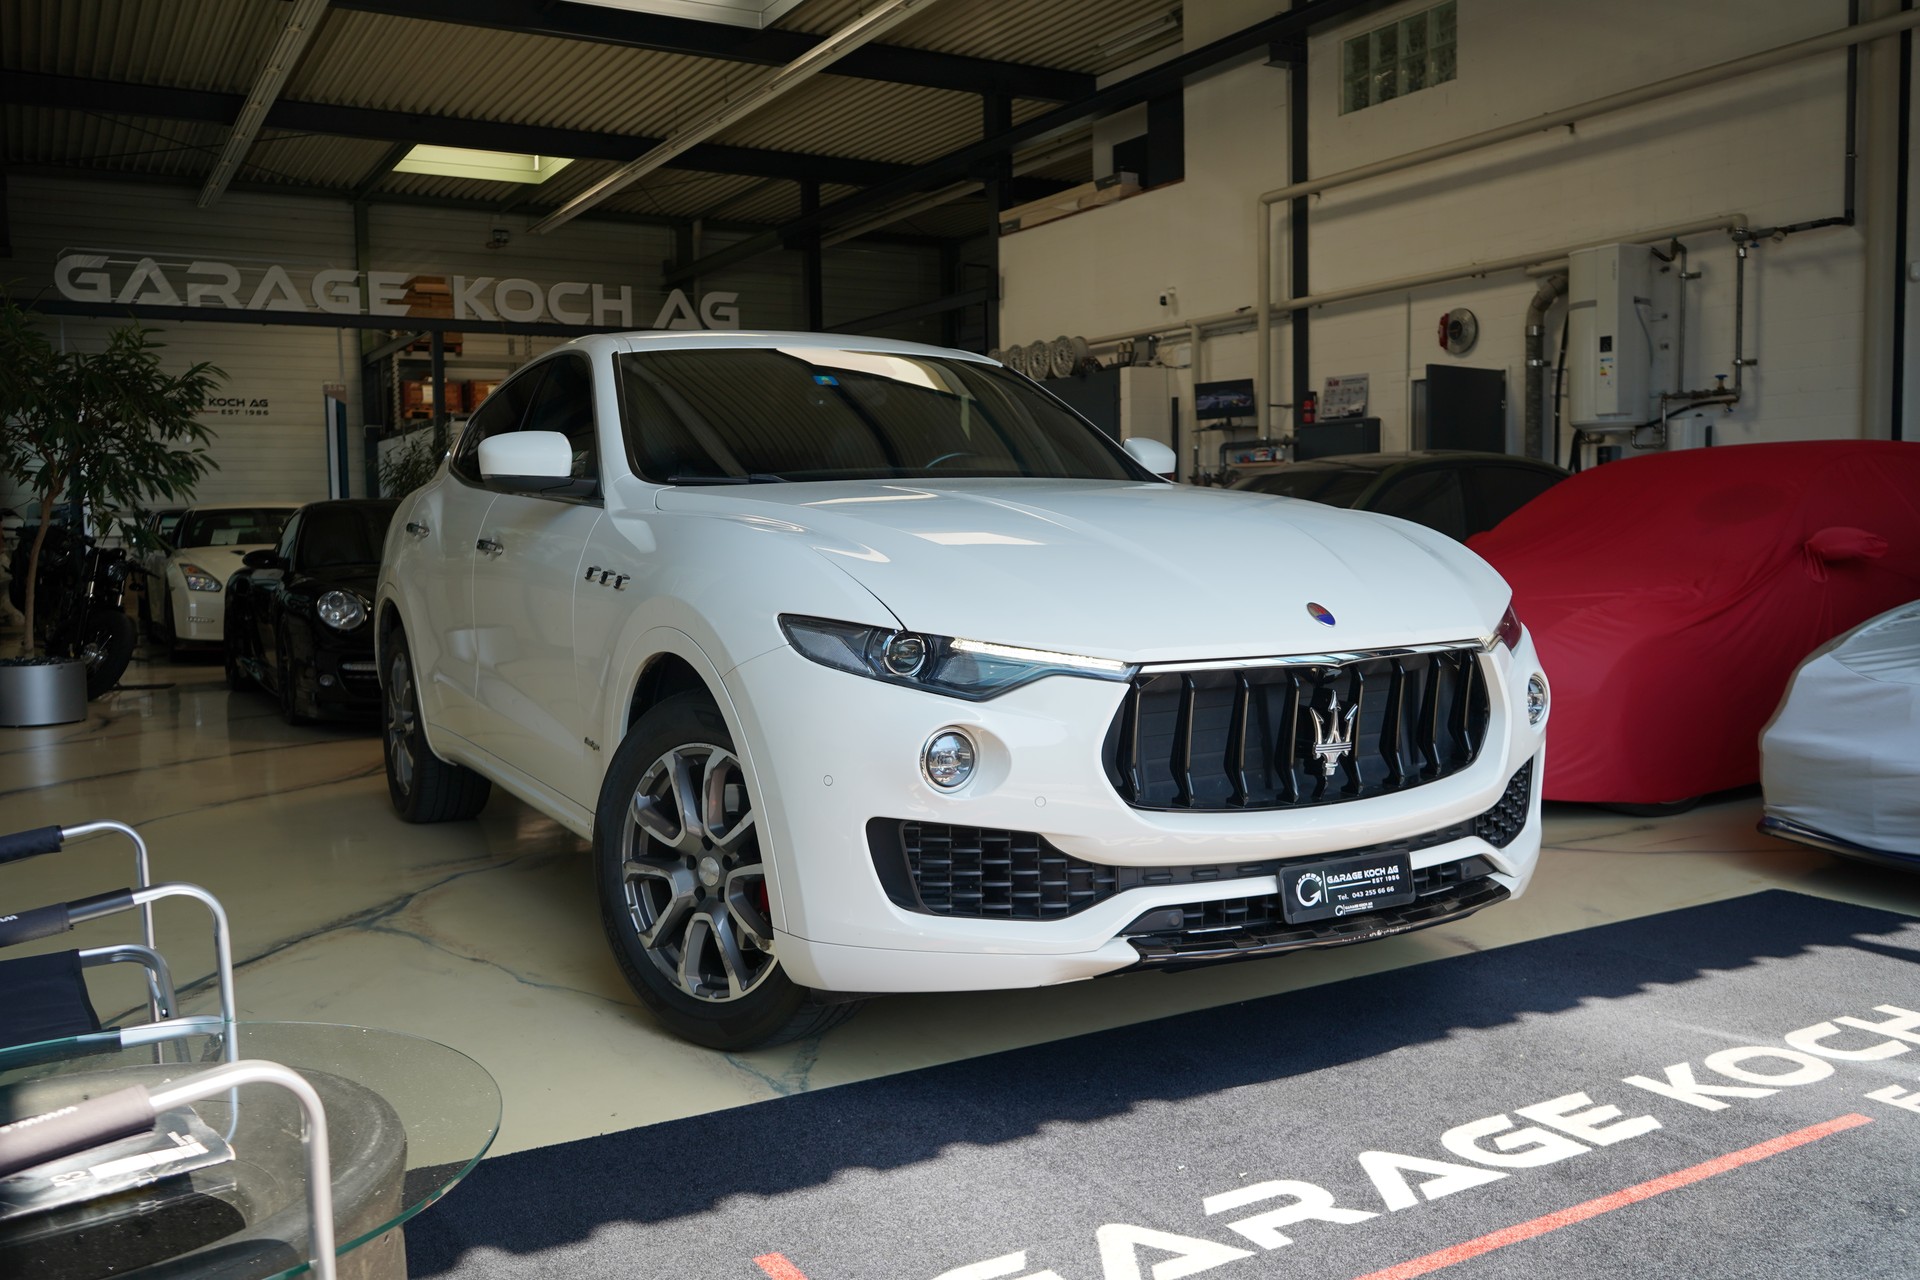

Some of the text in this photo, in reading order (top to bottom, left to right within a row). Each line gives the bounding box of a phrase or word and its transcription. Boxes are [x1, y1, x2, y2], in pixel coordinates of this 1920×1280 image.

[54, 254, 740, 330] GARAGE KOCH AG
[208, 398, 269, 407] KOCH AG
[1327, 865, 1399, 884] GARAGE KOCH AG
[1352, 891, 1364, 899] 043
[1622, 1004, 1920, 1111] KOCH
